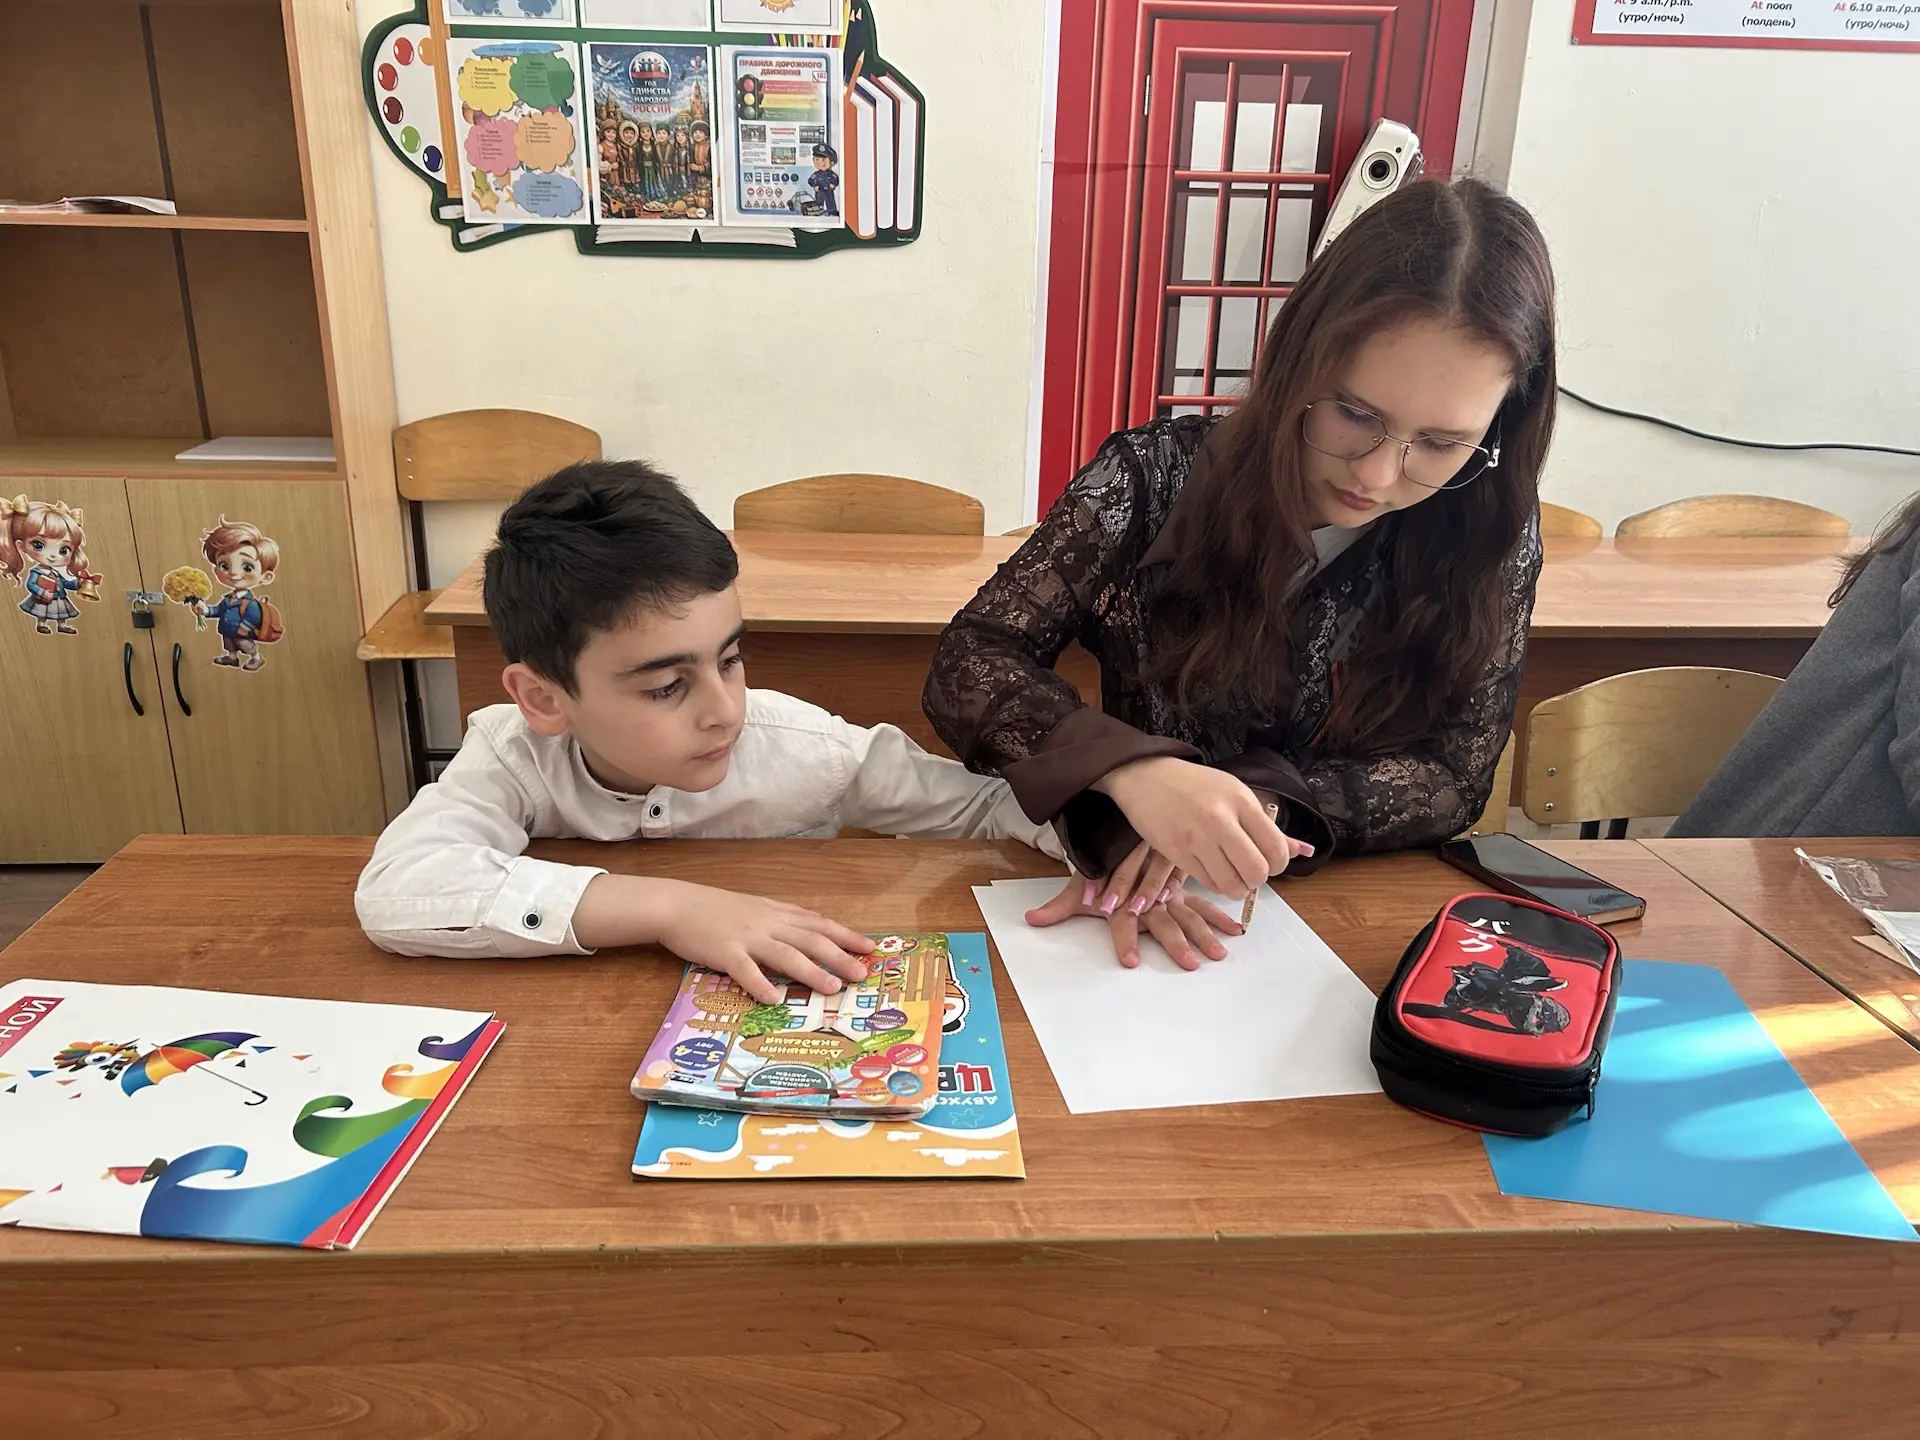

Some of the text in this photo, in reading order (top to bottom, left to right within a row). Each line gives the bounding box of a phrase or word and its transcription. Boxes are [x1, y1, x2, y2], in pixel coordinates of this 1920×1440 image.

[1751, 1, 1764, 9] At
[1833, 2, 1846, 11] At
[1618, 12, 1685, 24] (утро/ночь)
[1742, 16, 1796, 28] (полдень)
[1845, 18, 1910, 31] (утро/ночь)
[775, 61, 823, 69] ДОРОЖНОГО
[760, 68, 801, 76] ДВИЖЕНИЯ
[631, 87, 671, 95] ЕДИНСТВА
[634, 96, 669, 104] НАРОДОВ
[632, 104, 672, 113] РОССИИ
[0, 999, 57, 1046] НОЙ
[764, 1037, 840, 1048] академия
[758, 1046, 845, 1059] Домашняя
